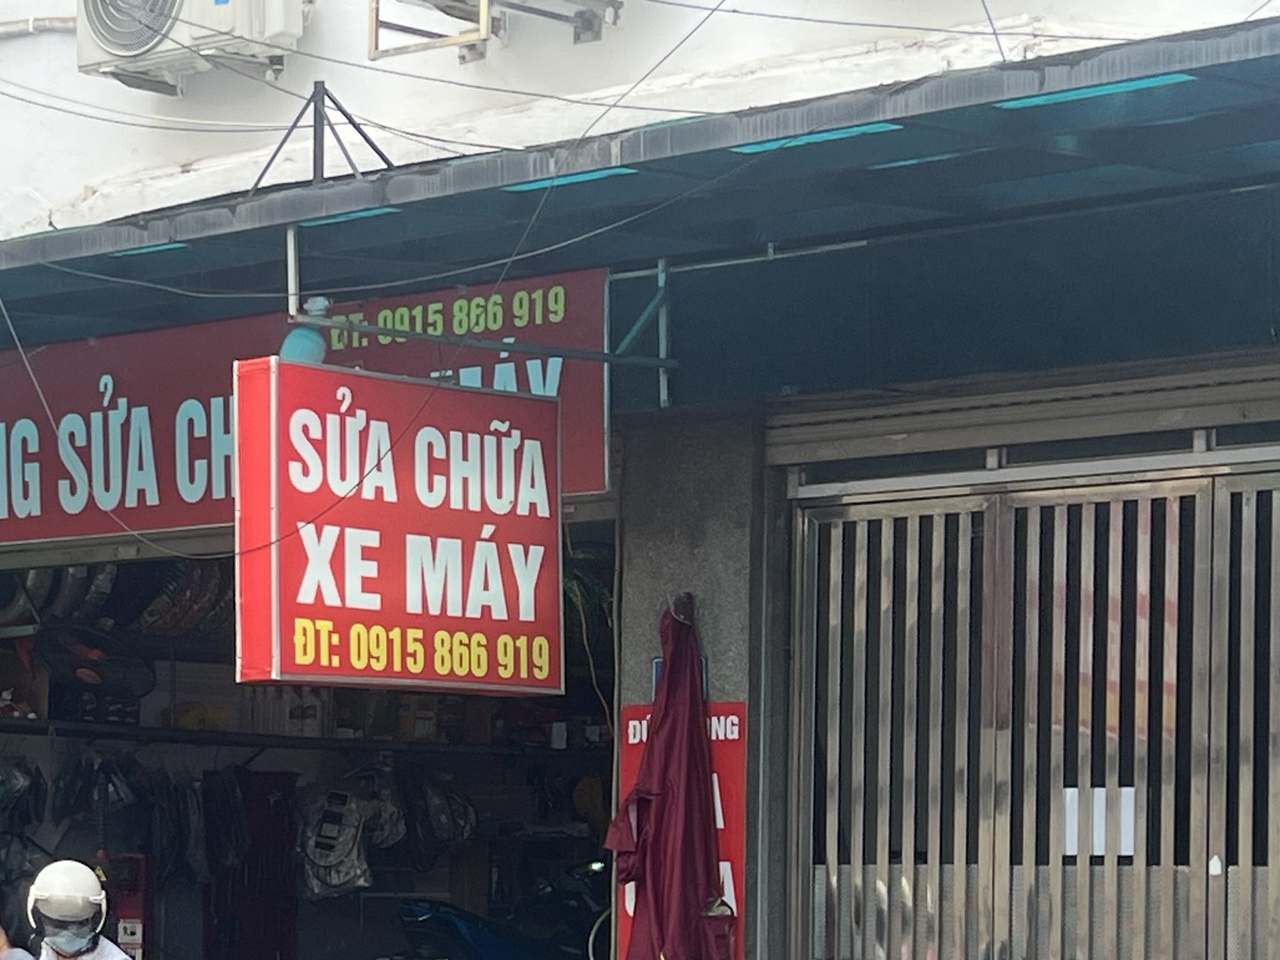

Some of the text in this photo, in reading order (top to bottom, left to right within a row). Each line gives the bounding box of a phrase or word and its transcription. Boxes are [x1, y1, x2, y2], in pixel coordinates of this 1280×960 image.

[377, 303, 443, 345] 0915
[453, 294, 503, 335] 866
[513, 286, 565, 328] 919
[58, 374, 160, 514] SỬA
[175, 394, 236, 504] CH
[288, 387, 550, 518] SỬA CHỮA
[296, 522, 544, 622] XE MÁY
[293, 618, 549, 680] ĐT: 0915 866 919
